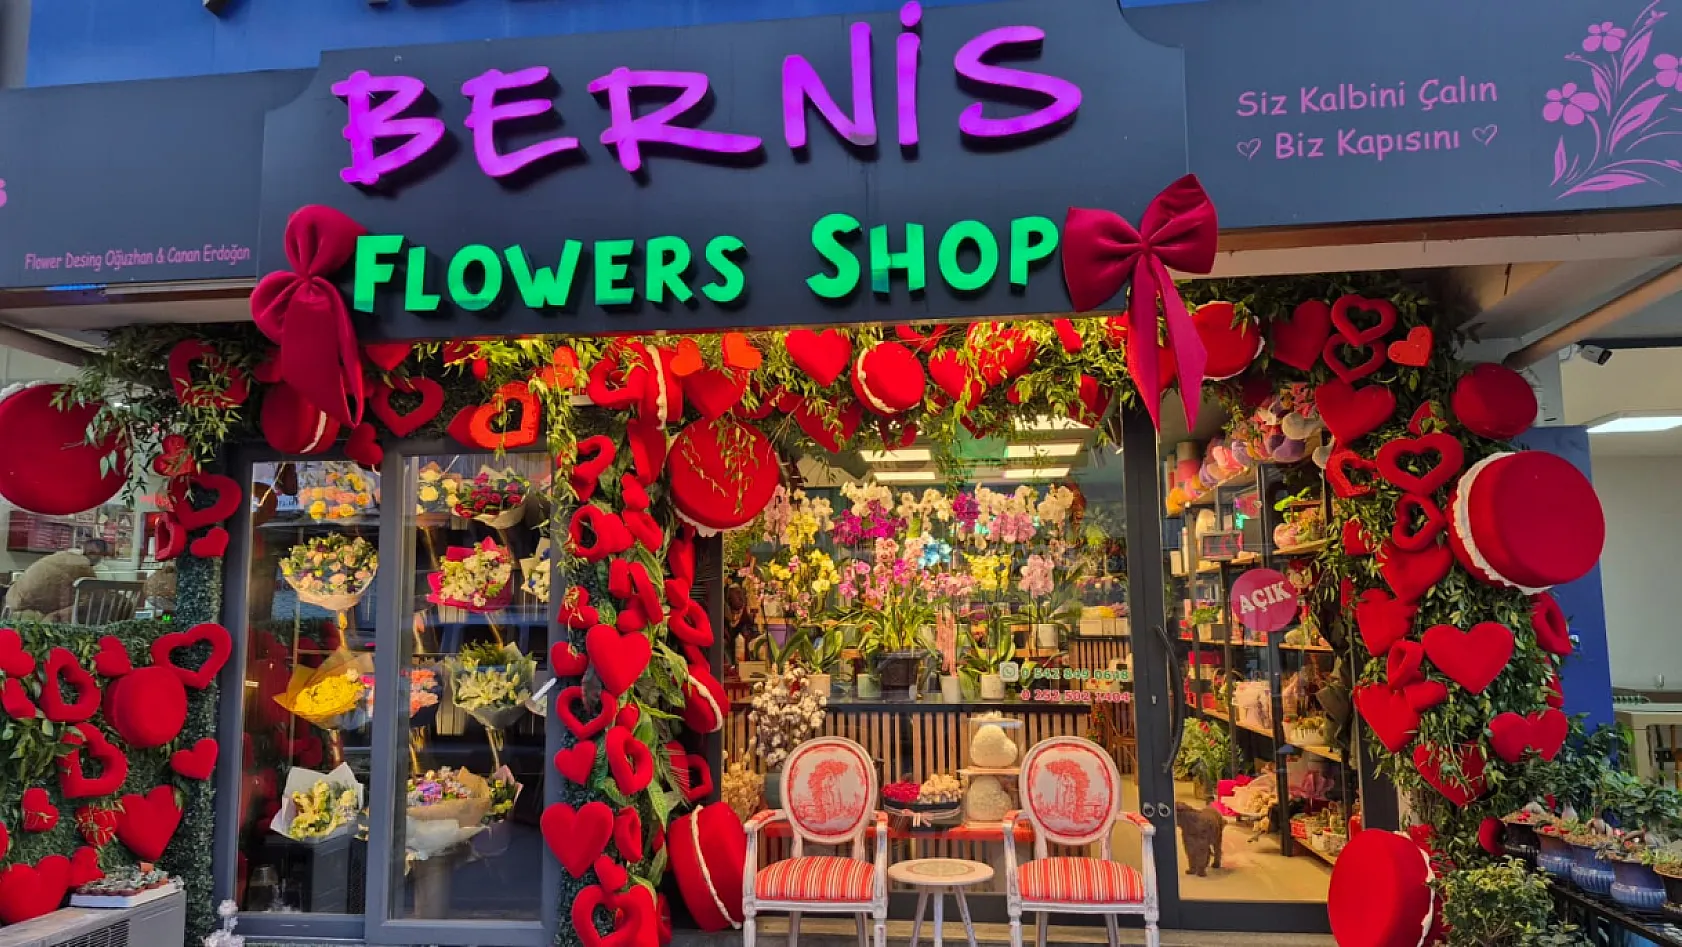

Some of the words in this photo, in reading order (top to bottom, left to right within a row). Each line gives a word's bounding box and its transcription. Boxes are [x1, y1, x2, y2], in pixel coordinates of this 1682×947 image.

[1236, 90, 1288, 118] Siz
[1299, 81, 1405, 114] Kalbini
[1418, 75, 1498, 111] Çalın
[1274, 132, 1324, 160] Biz
[1336, 126, 1461, 161] Kapısını
[24, 253, 62, 270] Flower
[65, 252, 102, 272] Desing
[104, 249, 153, 271] Oğuzhan
[155, 247, 165, 264] &
[167, 247, 201, 264] Canan
[203, 244, 251, 266] Erdoğan
[353, 235, 746, 313] FLOWERS
[806, 213, 1059, 298] SHOP
[1239, 580, 1292, 614] AÇIK
[1021, 690, 1031, 701] 0
[1034, 690, 1060, 701] 252
[1064, 690, 1091, 702] 502
[1095, 692, 1131, 704] 1404
